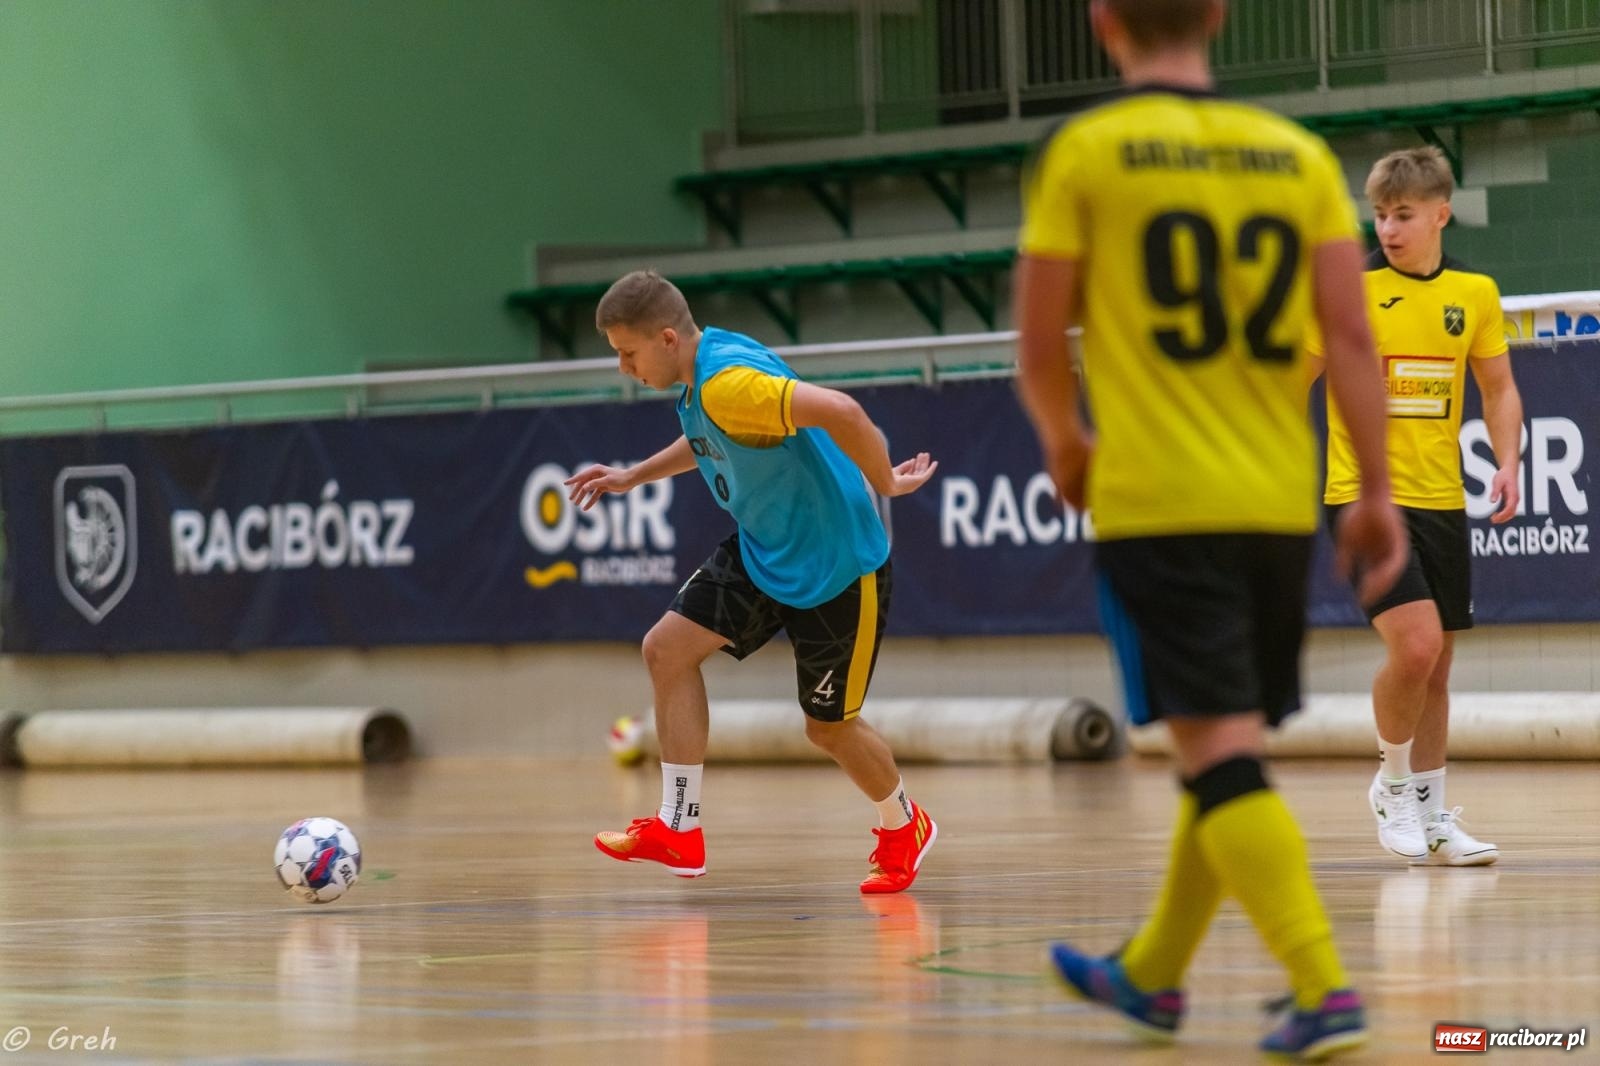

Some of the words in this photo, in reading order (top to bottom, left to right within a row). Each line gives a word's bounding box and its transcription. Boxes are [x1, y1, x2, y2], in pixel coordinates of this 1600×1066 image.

[1143, 209, 1300, 364] 92
[170, 479, 415, 575] RACIBÓRZ
[520, 460, 676, 555] OSiR
[941, 471, 1097, 547] RACI
[1470, 516, 1590, 557] RACIBÓRZ
[814, 669, 836, 698] 4
